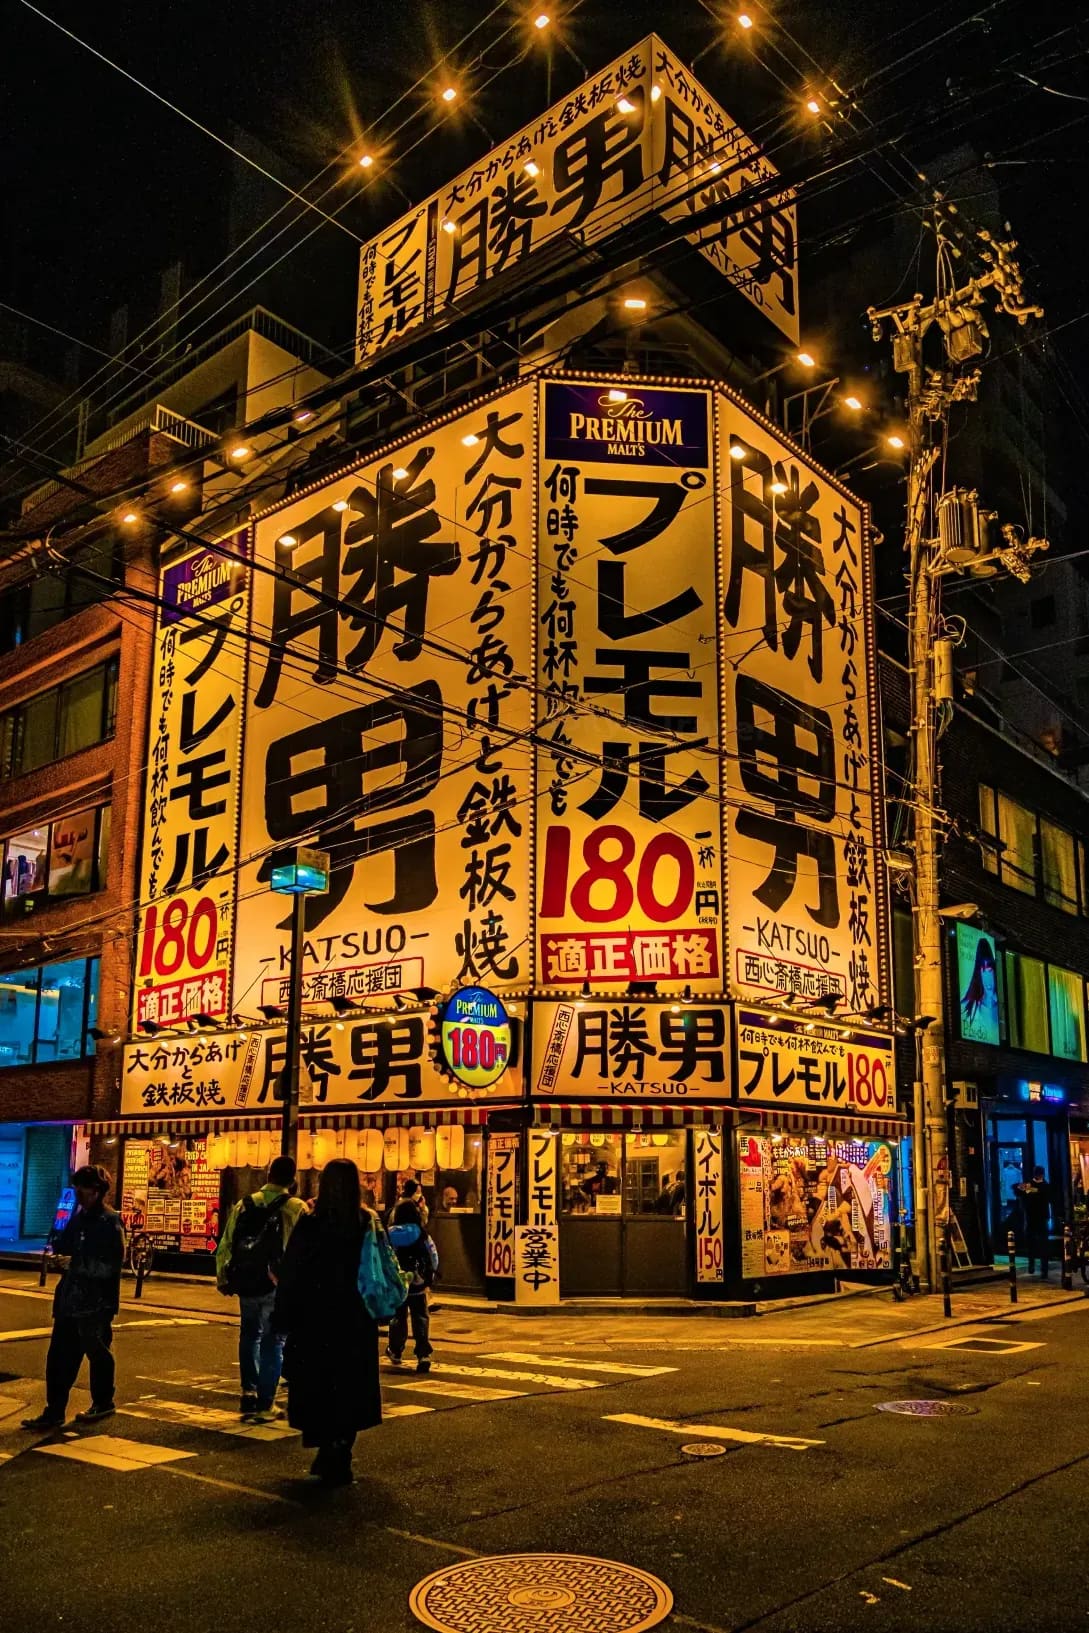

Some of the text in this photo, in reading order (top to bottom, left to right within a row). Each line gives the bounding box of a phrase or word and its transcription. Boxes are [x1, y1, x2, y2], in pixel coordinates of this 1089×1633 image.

[445, 53, 648, 214] 大分からあげと鉄板焼
[448, 86, 648, 304] 勝男
[376, 208, 426, 345] プレモル
[569, 412, 685, 446] PREMIUM
[607, 442, 646, 457] MALT'S
[176, 561, 231, 605] PREMIUM
[541, 463, 581, 817] 何時でも何杯飲んでも
[577, 470, 711, 823] プレモル
[254, 447, 461, 931] 勝男
[455, 411, 527, 984] 大分からあげと鉄板焼
[724, 433, 841, 929] 勝男
[147, 628, 177, 899] 何時でも何杯飲んでも
[165, 596, 243, 894] プレモル
[833, 504, 876, 1012] 大分からあげと鉄板焼
[539, 824, 696, 924] 180
[694, 830, 716, 870] 一杯
[695, 889, 720, 917] 円
[139, 896, 218, 977] 180
[215, 937, 229, 961] 円
[546, 935, 713, 981] 適正価格
[139, 976, 225, 1022] 適正価格
[278, 964, 402, 1004] 西心斎橋応援団
[744, 955, 841, 998] 西心斎橋応援団
[456, 999, 498, 1019] PREMIUM
[127, 1039, 247, 1075] 大分からあげ
[181, 1064, 193, 1080] と
[257, 1015, 425, 1105] 勝男
[541, 1008, 570, 1088] 西心斎橋応援団
[569, 1005, 727, 1083] 勝男
[740, 1027, 846, 1058] 何時でも何杯飲んでも
[141, 1079, 226, 1108] 鉄板焼
[739, 1046, 888, 1108] プレモル 180
[493, 1148, 515, 1241] プレモル
[697, 1132, 721, 1238] ハイボール
[487, 1241, 512, 1275] 180
[520, 1228, 554, 1292] 営業中
[698, 1237, 722, 1270] 150
